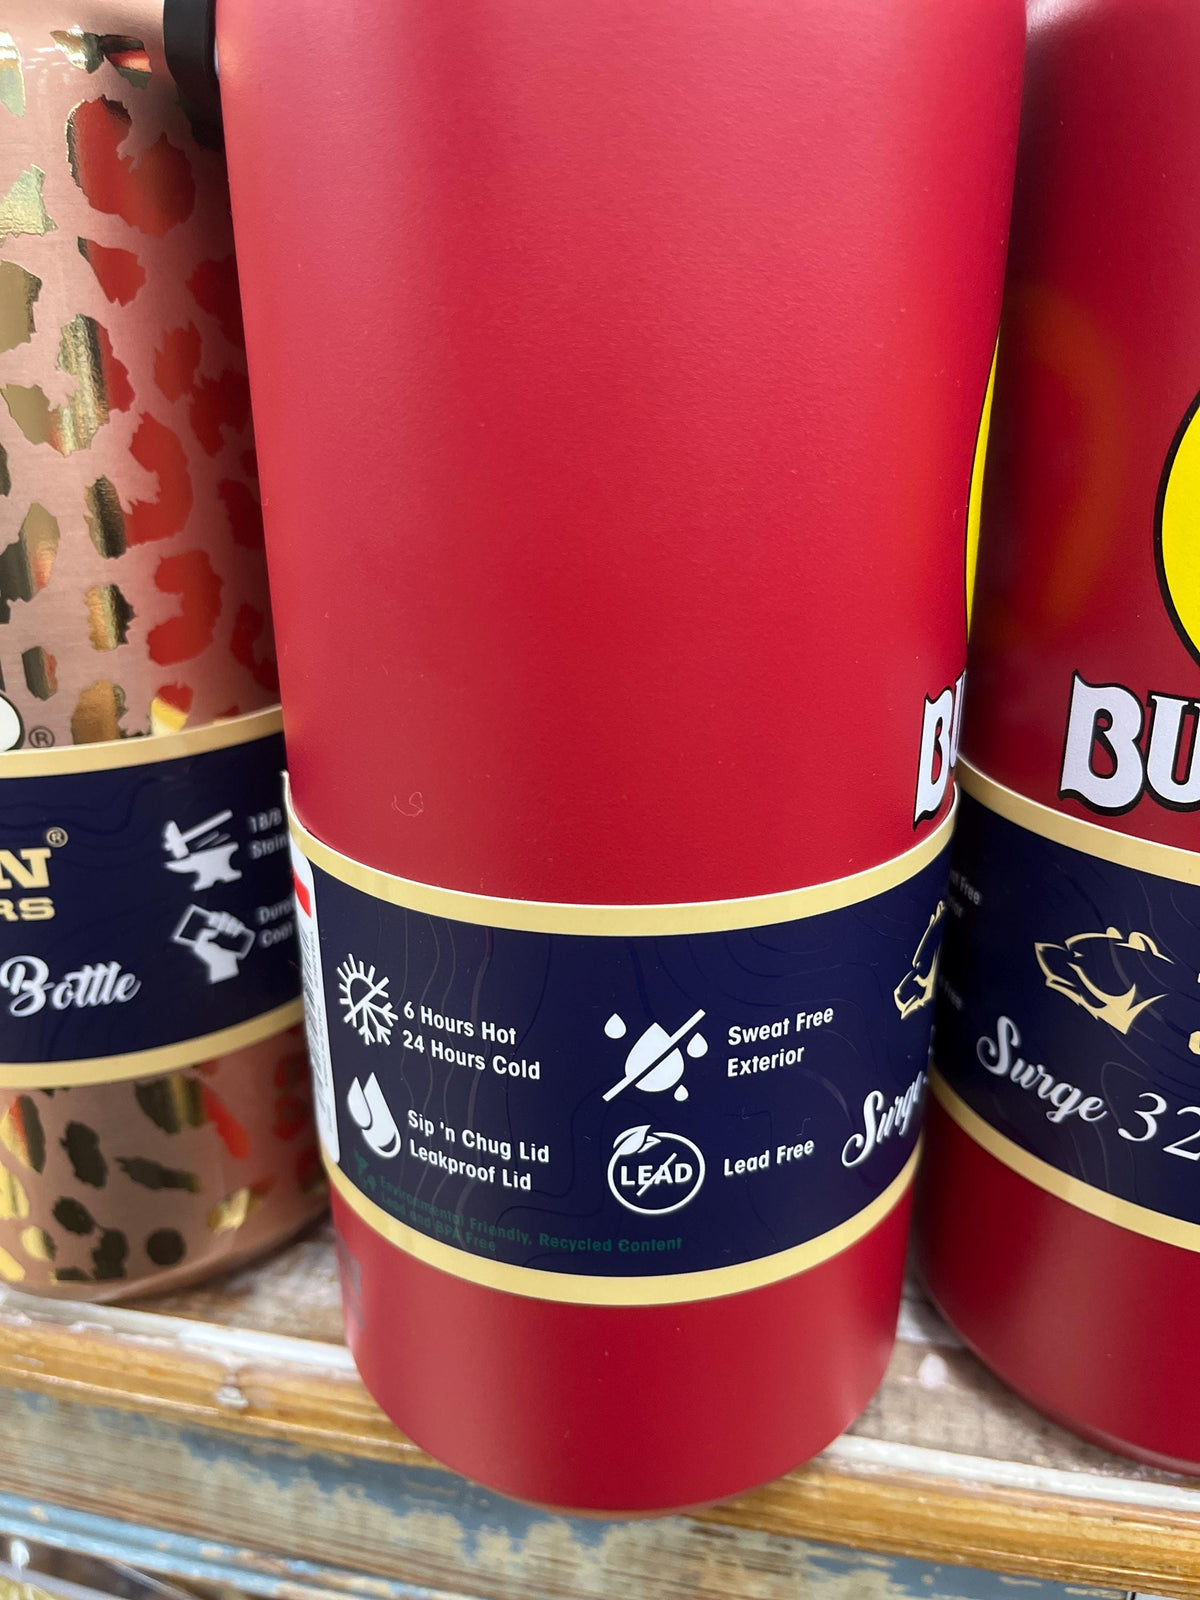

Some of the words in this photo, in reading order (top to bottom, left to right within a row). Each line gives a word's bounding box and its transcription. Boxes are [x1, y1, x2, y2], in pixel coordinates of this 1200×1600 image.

[0, 955, 142, 1017] Bottle
[403, 1001, 415, 1019] 6
[420, 1004, 475, 1037] Hours
[482, 1021, 516, 1045] Hot
[727, 1017, 790, 1046] Sweat
[796, 1006, 834, 1032] Free
[403, 1030, 425, 1053] 24
[431, 1039, 486, 1071] Hours
[492, 1054, 541, 1080] Cold
[727, 1046, 805, 1078] Exterior
[976, 1016, 1107, 1123] Surge
[407, 1109, 435, 1136] Sip
[461, 1128, 512, 1160] Chug
[519, 1141, 550, 1163] Lid
[723, 1150, 770, 1177] Lead
[776, 1139, 815, 1164] Free
[409, 1138, 496, 1184] Leakproof
[502, 1168, 532, 1190] Lid
[620, 1162, 693, 1186] LEAD
[539, 1232, 612, 1253] Recycled
[618, 1236, 683, 1253] Content
